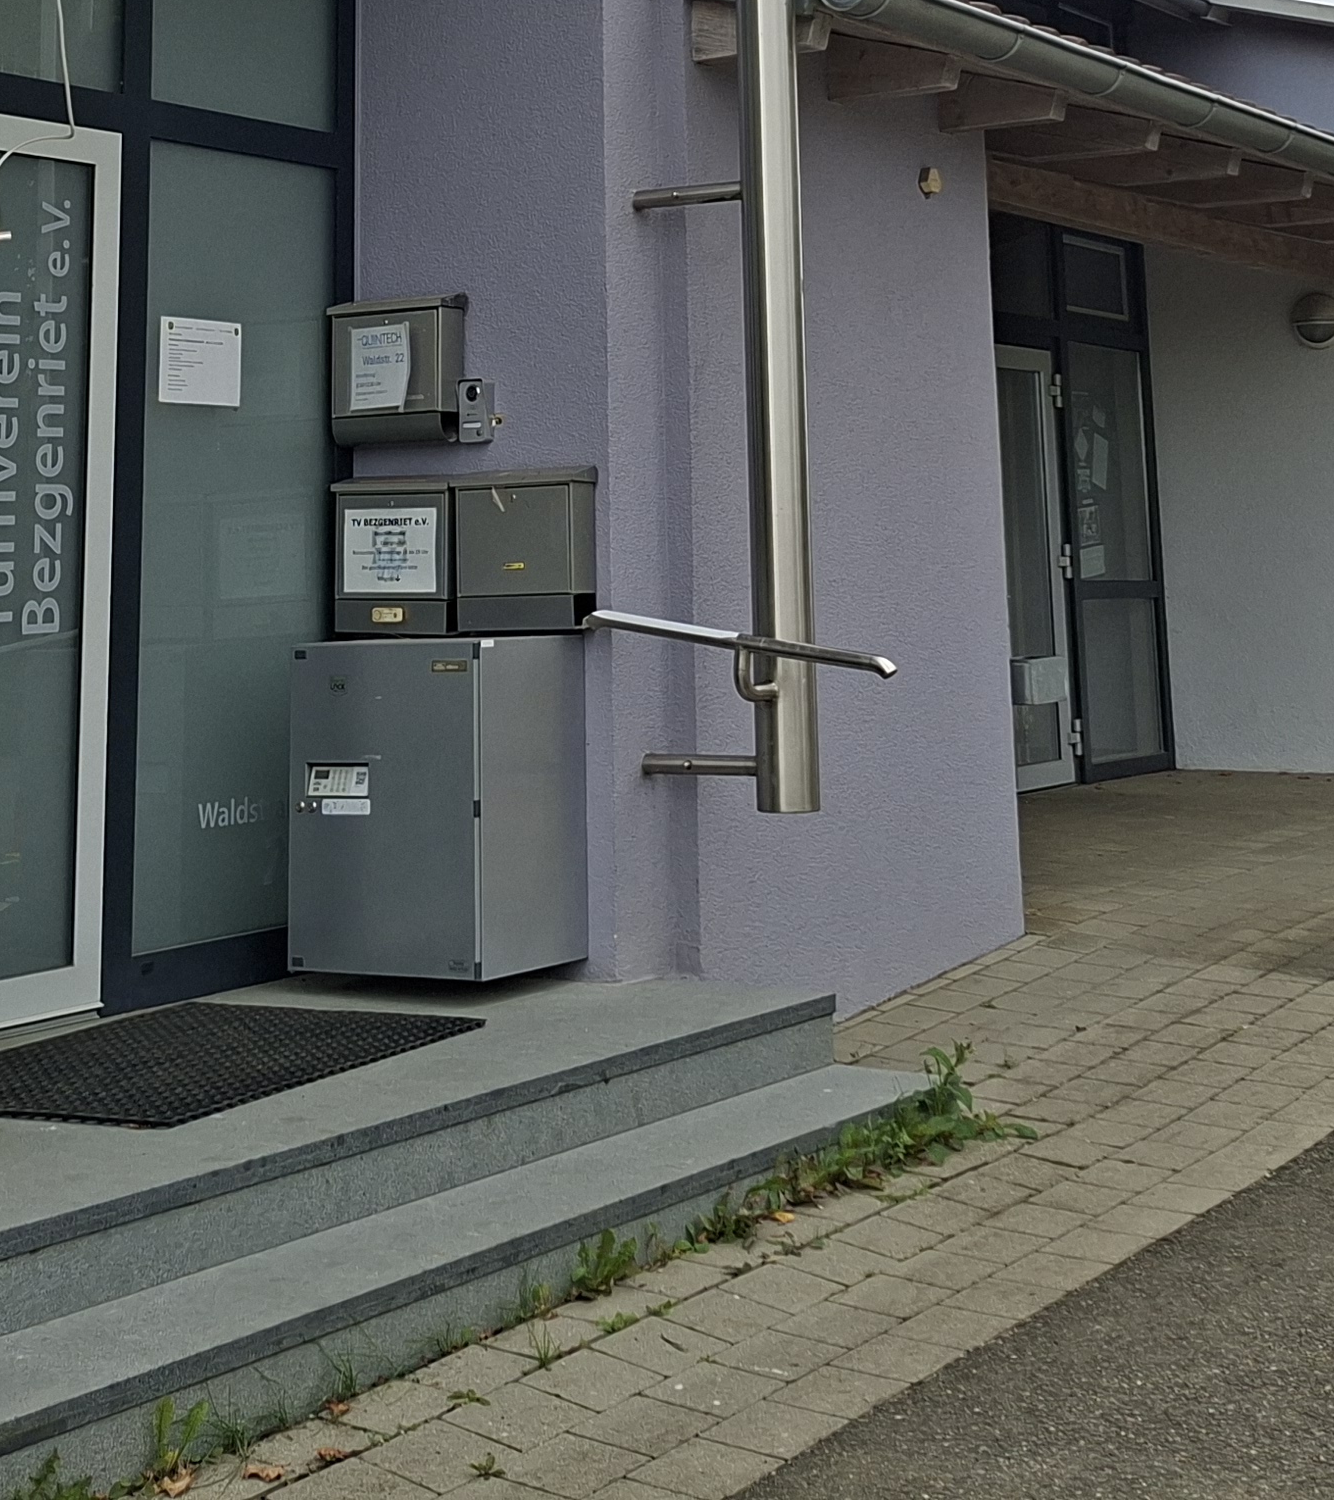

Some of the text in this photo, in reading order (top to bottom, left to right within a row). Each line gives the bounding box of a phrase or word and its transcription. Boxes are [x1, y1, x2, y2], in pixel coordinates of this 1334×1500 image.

[21, 293, 74, 635] Bezgenriet
[351, 518, 362, 527] TV
[363, 517, 413, 527] BEZGENRIET
[197, 796, 263, 829] Walds
